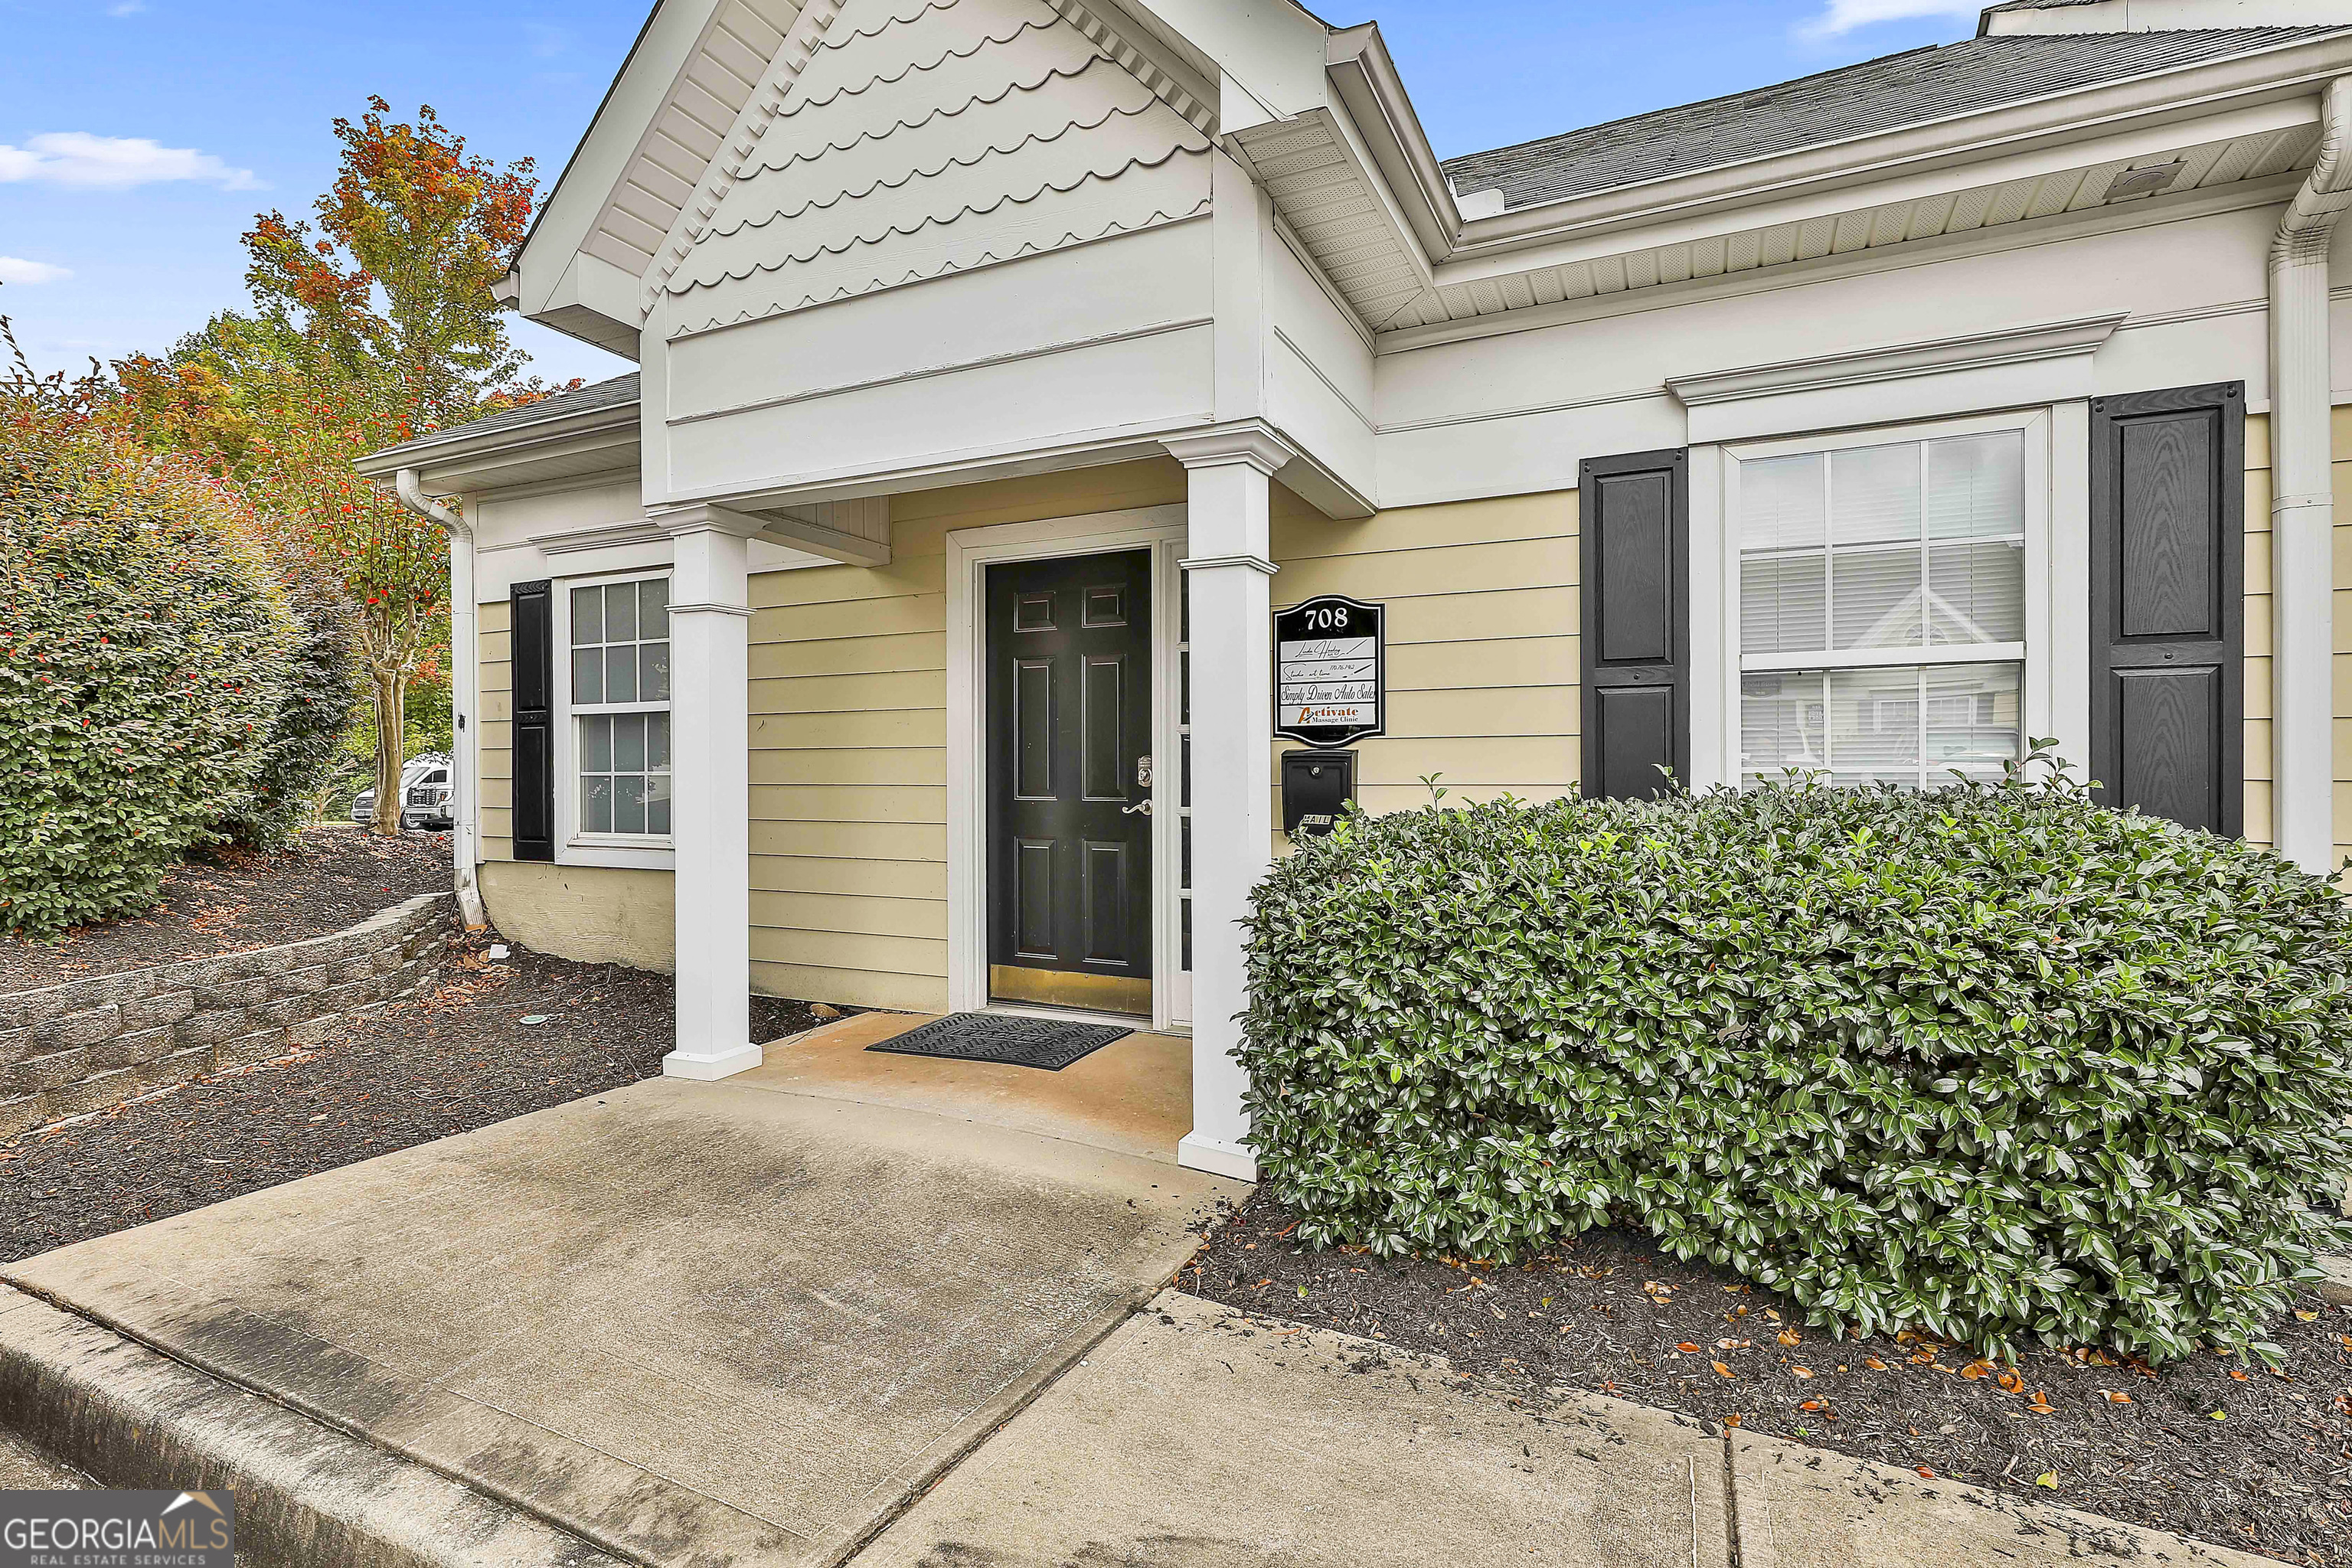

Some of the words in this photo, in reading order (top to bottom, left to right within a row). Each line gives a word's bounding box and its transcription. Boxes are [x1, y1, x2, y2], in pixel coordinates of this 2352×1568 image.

[1305, 608, 1348, 630] 708
[1283, 663, 1306, 681] Studio
[1282, 685, 1305, 704] Simply
[1306, 684, 1332, 701] Driven
[1334, 684, 1355, 700] Auto
[1357, 684, 1375, 700] Sales
[1297, 707, 1358, 724] Activate
